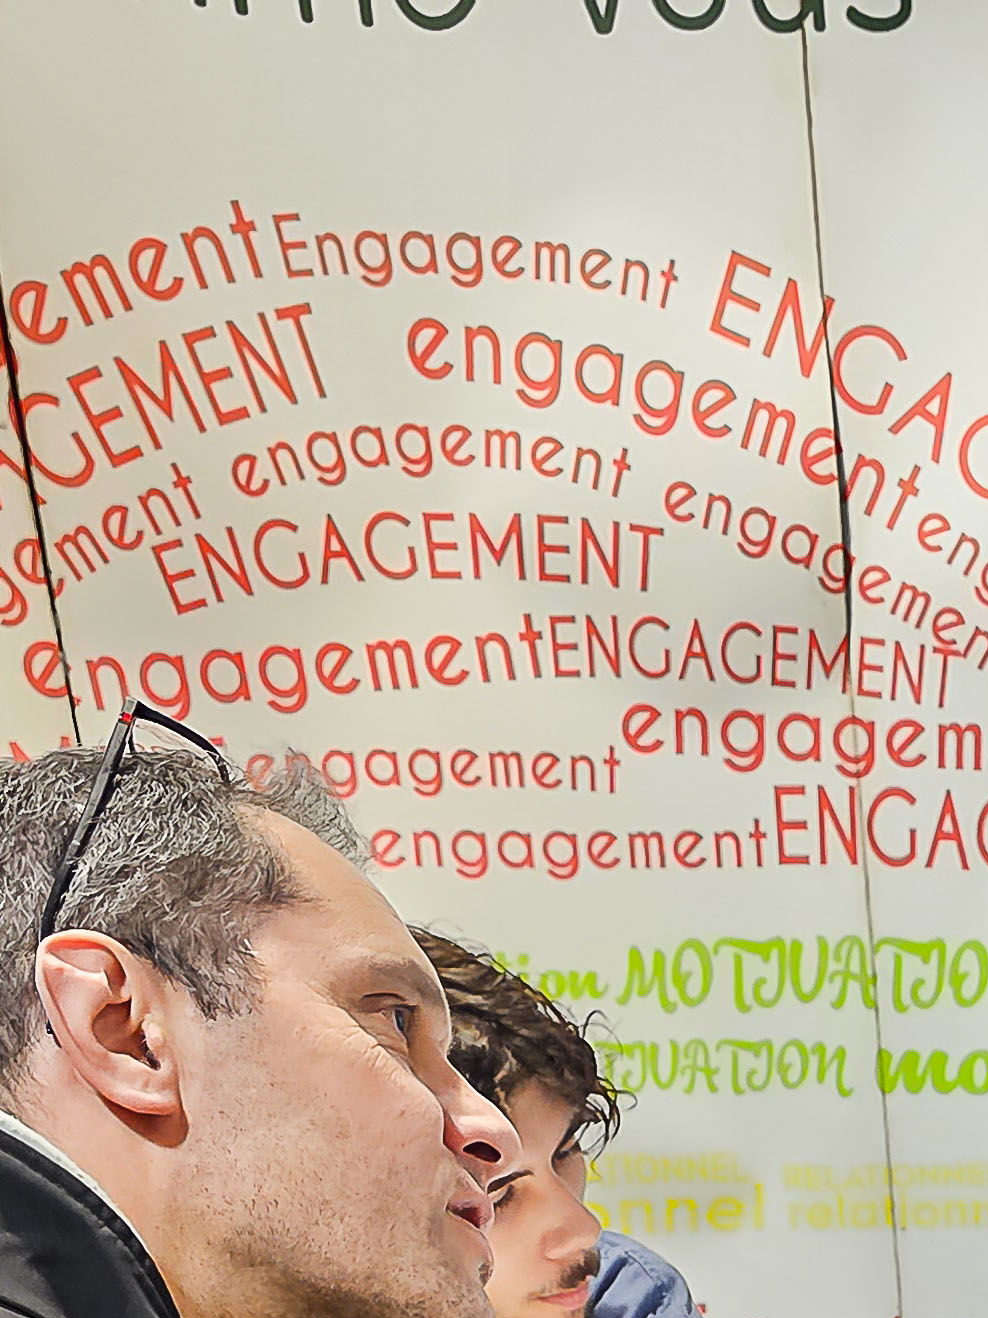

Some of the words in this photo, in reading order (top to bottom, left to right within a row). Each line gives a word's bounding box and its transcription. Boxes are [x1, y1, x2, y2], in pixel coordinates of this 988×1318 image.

[0, 199, 262, 377] ement
[272, 213, 678, 309] Engagement
[231, 423, 631, 499] engagement
[406, 317, 921, 531] engagement
[150, 511, 664, 616] ENGAGEMENT
[23, 612, 543, 722] engagement
[549, 614, 966, 709] ENGAGEMENT
[244, 745, 620, 801] engagement
[369, 819, 767, 882] engagement
